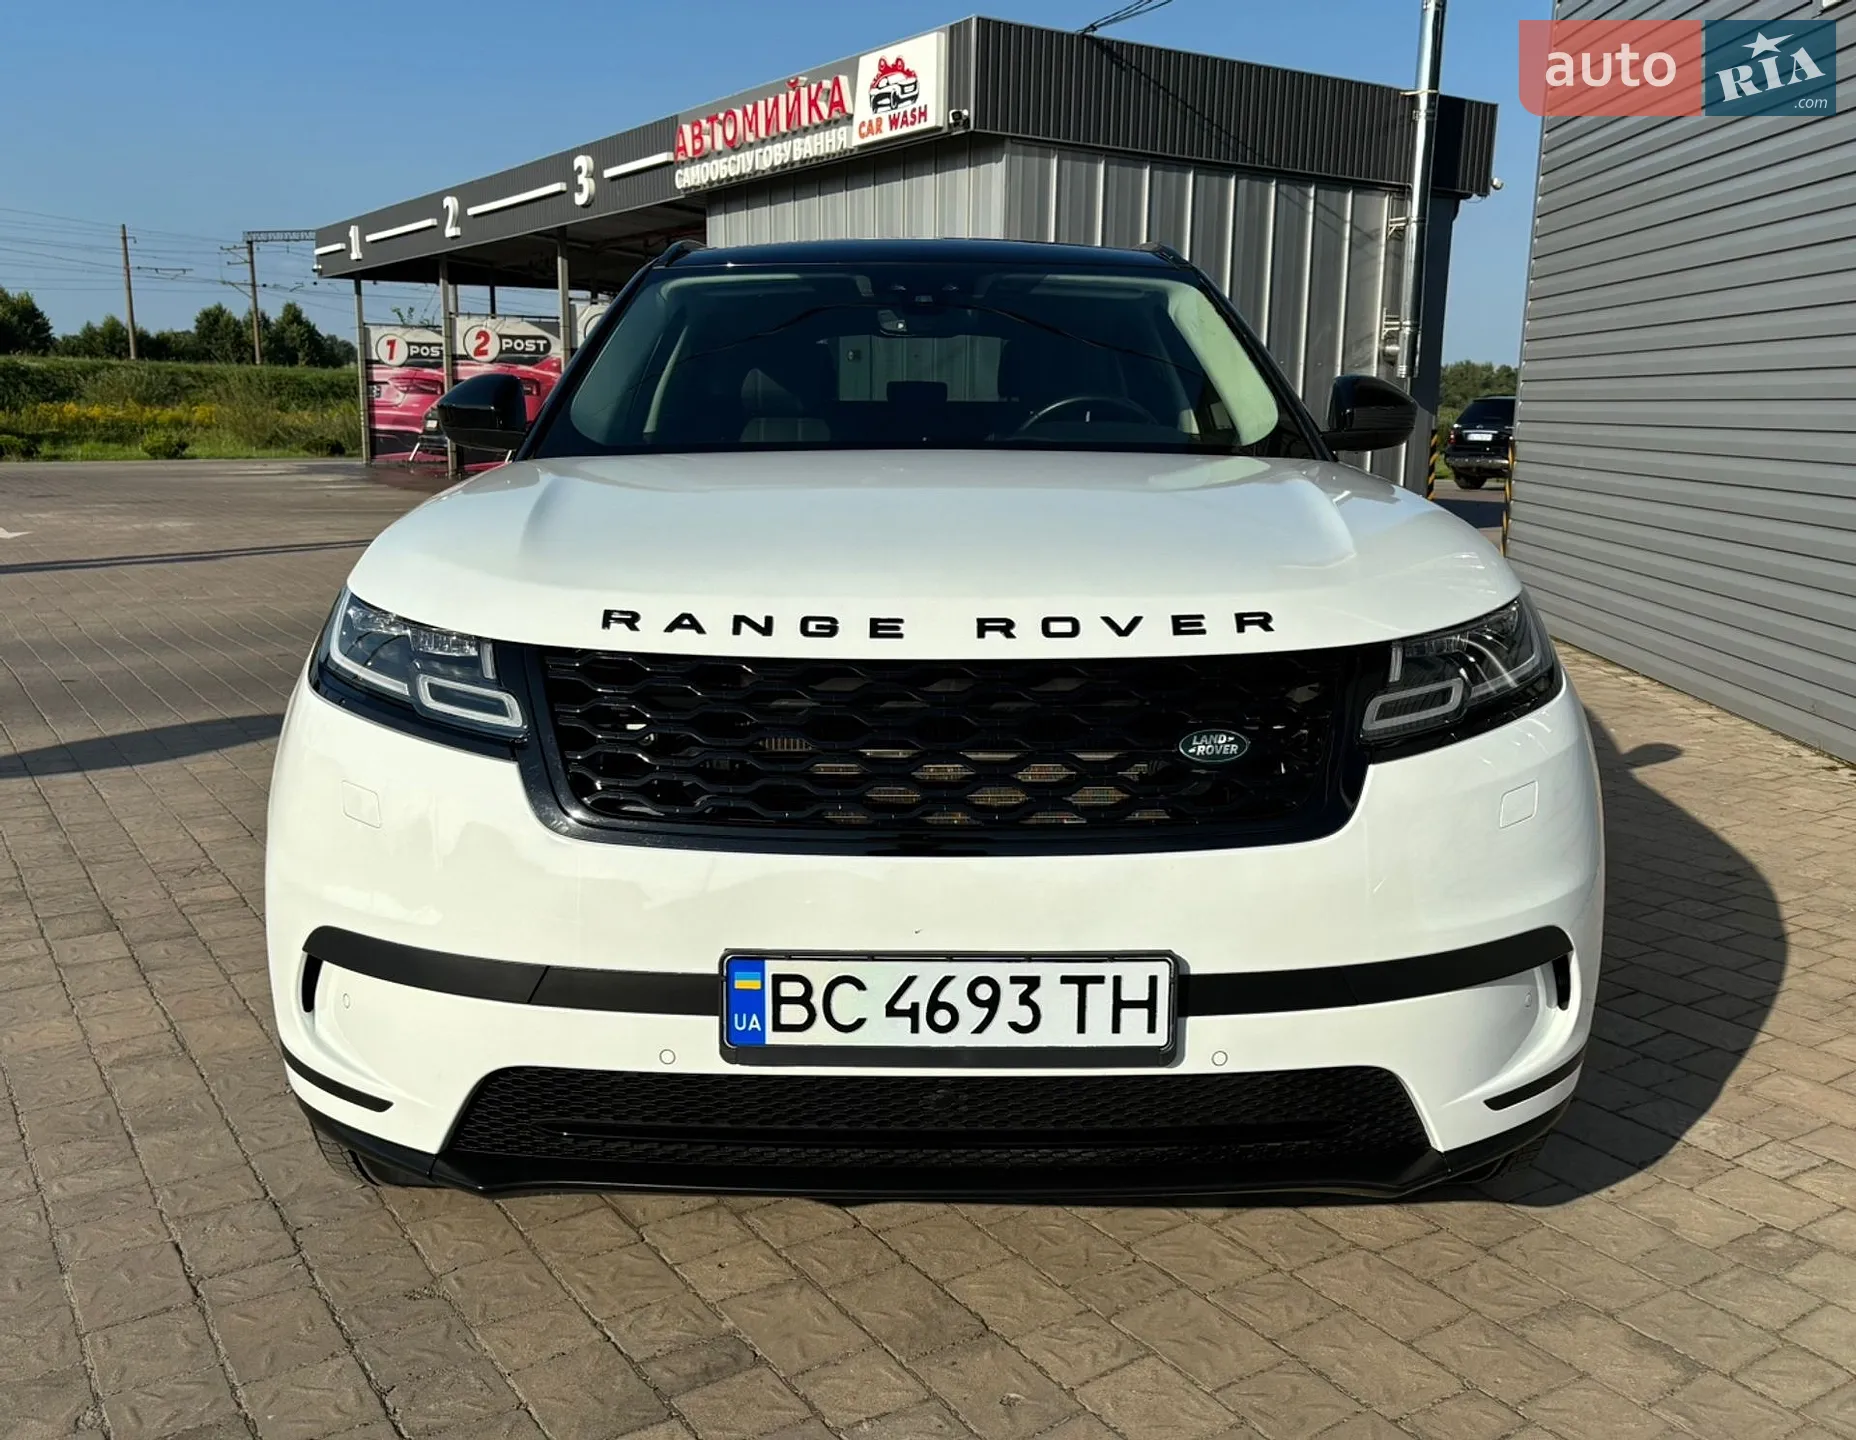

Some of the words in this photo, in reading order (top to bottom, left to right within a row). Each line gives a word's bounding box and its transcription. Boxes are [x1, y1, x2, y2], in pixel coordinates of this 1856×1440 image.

[673, 74, 853, 163] АВТОМИЙКА
[858, 116, 883, 140] CAR
[888, 104, 928, 131] WASH
[675, 126, 850, 191] САМООБСЛУГОВУВАННЯ
[573, 155, 597, 207] 3
[443, 196, 461, 238] 2
[349, 225, 363, 261] 1
[386, 339, 398, 361] 1
[409, 345, 443, 357] POS
[473, 330, 491, 358] 2
[501, 339, 548, 353] POST
[601, 609, 905, 639] RANGE
[976, 611, 1274, 639] ROVER
[1192, 733, 1227, 746] LAND
[1196, 744, 1239, 756] ROVER
[771, 973, 867, 1034] BC
[884, 974, 1042, 1035] 4693
[1060, 974, 1158, 1034] TH
[734, 1012, 762, 1033] UA
